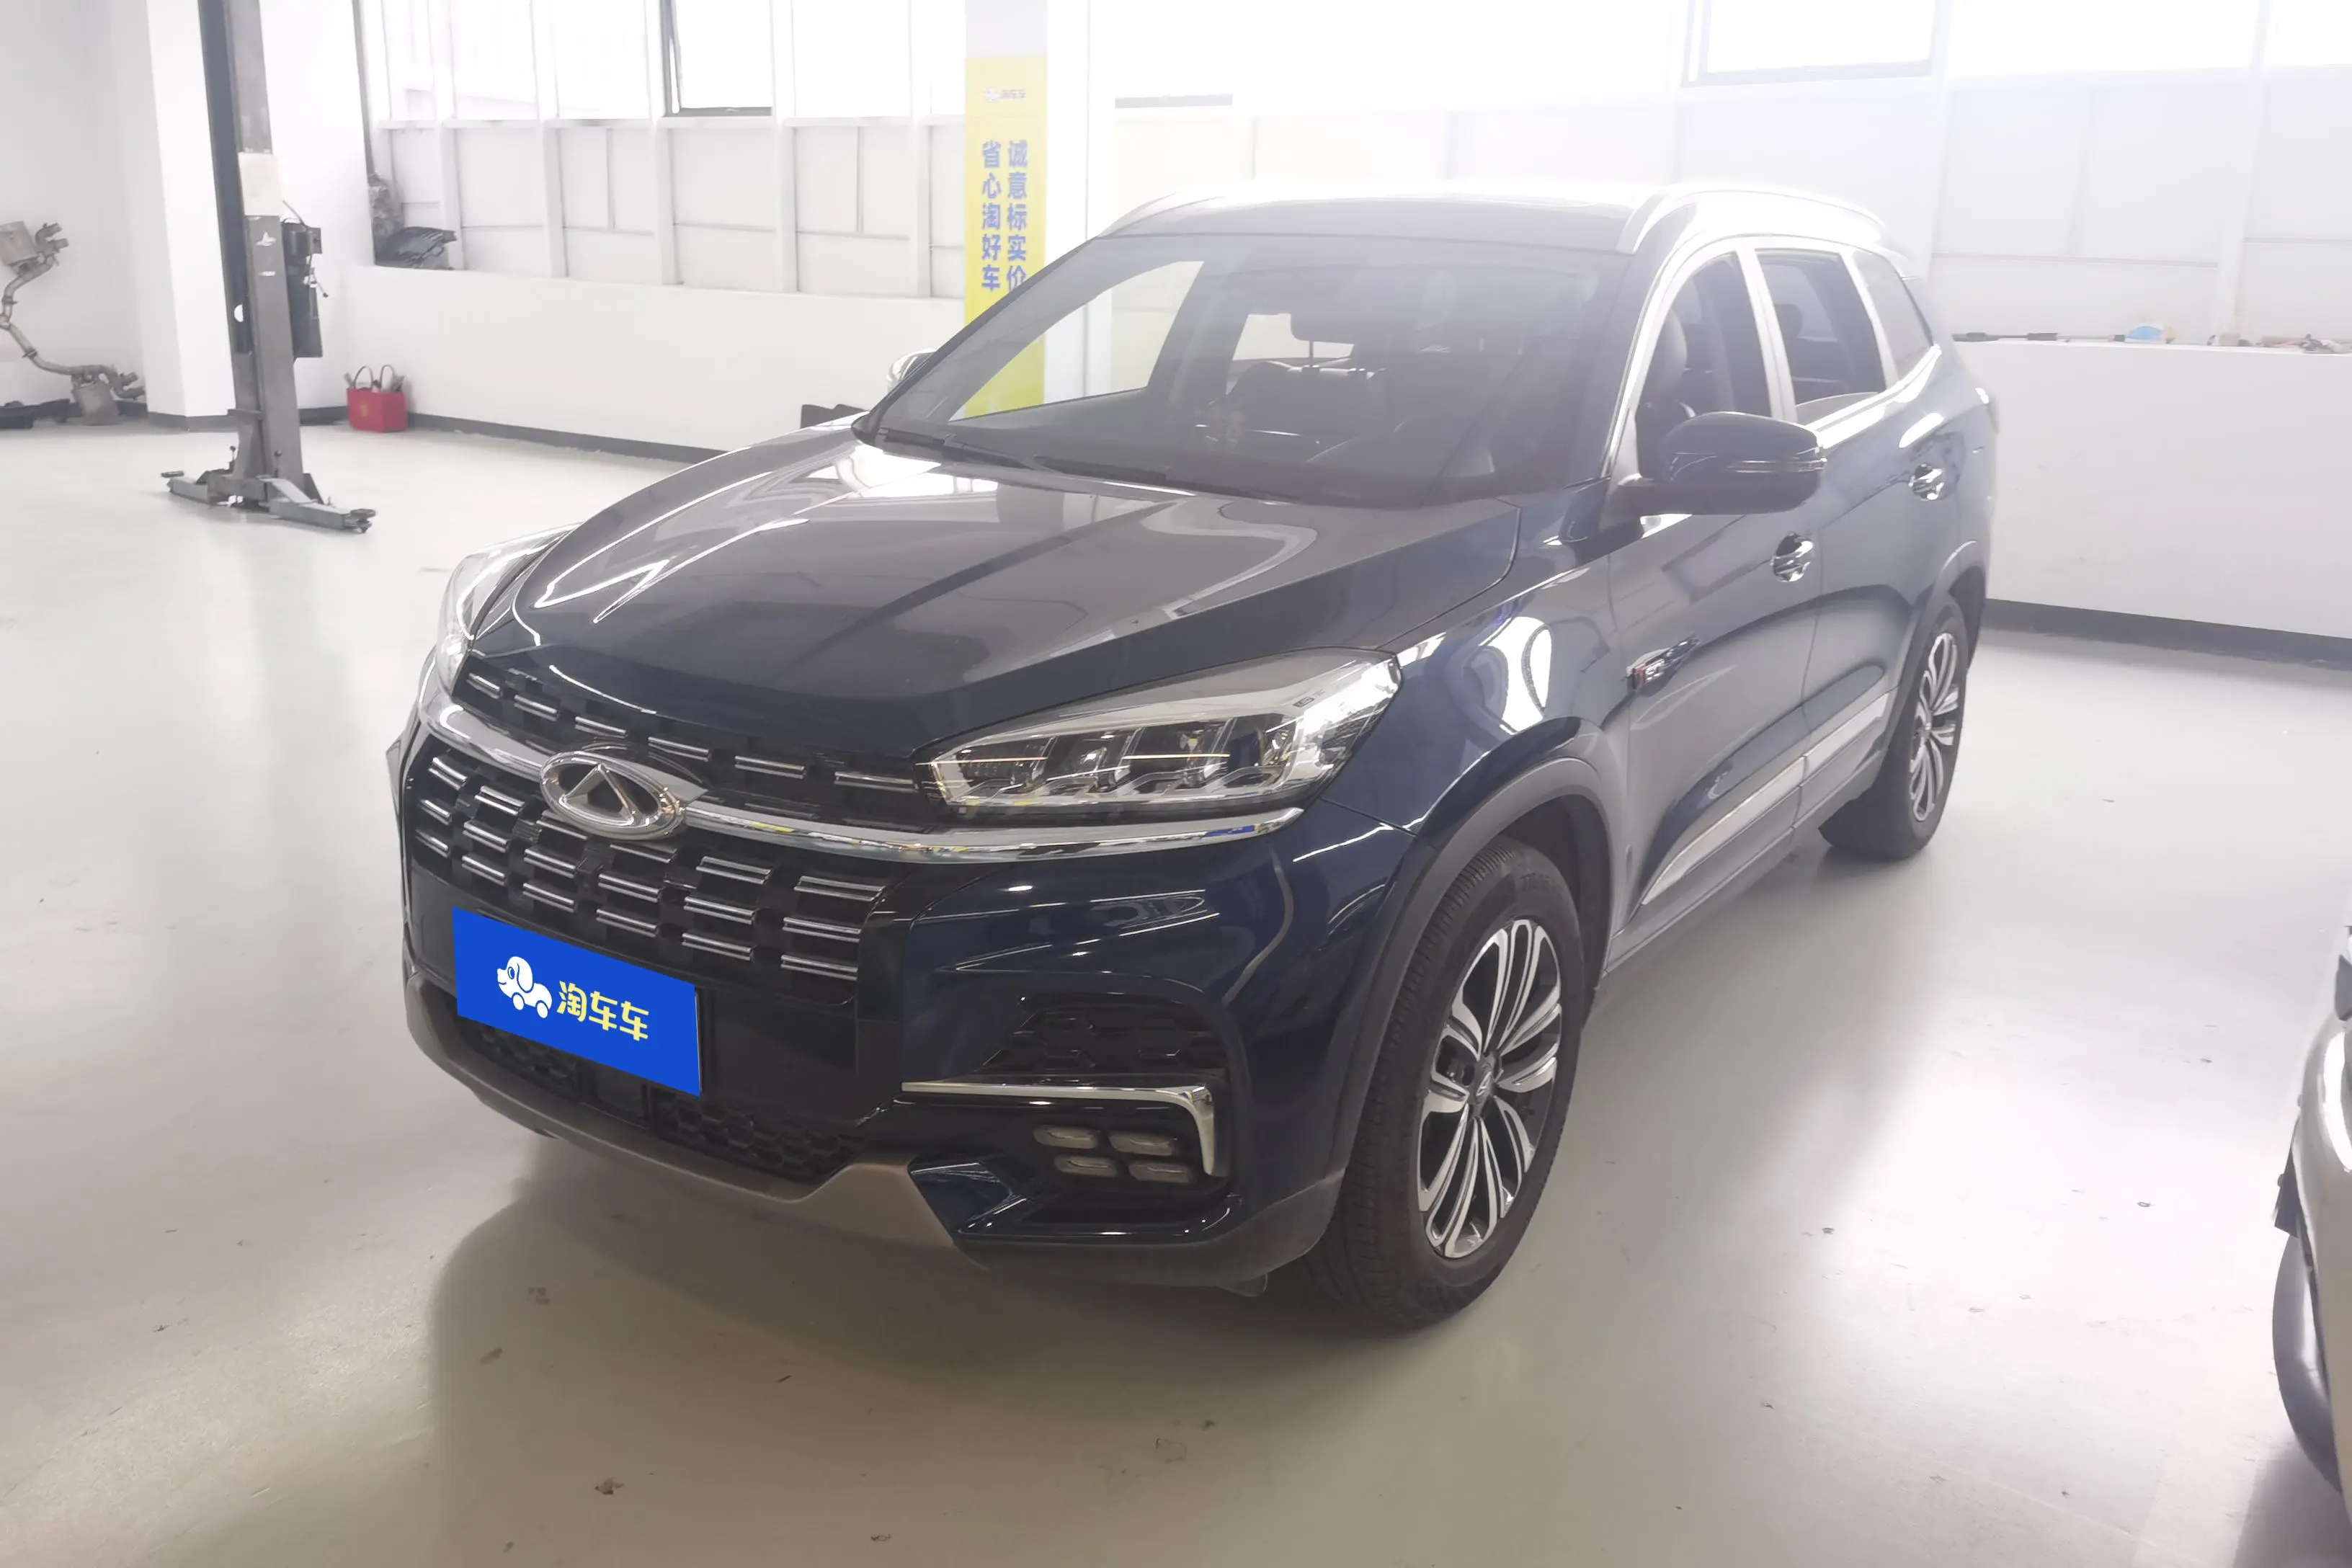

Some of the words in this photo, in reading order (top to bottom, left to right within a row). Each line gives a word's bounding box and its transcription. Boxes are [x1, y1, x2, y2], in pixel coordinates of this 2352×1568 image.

[981, 140, 1002, 292] 省心淘好车
[1007, 139, 1028, 293] 诚意标实价
